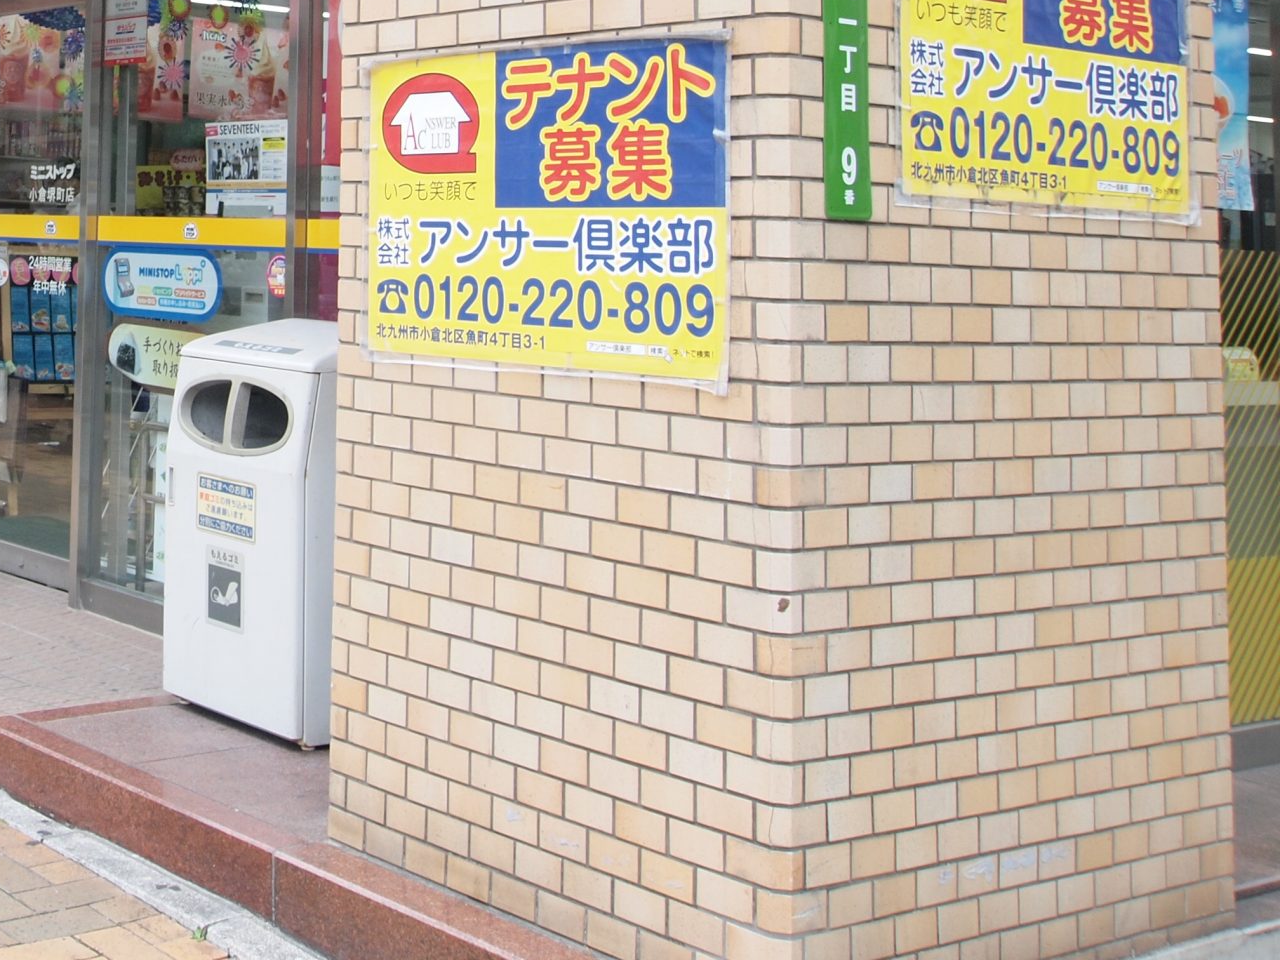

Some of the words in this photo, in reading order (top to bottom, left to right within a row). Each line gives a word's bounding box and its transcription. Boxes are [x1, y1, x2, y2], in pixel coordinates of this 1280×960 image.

[910, 40, 944, 68] 株式
[503, 43, 716, 129] テナント
[910, 69, 944, 97] 会社
[954, 46, 1179, 123] アンサー倶楽部
[219, 123, 260, 136] SEVENTEEN
[949, 107, 1180, 177] 0120-220-809
[30, 163, 76, 180] ミニストップ
[539, 122, 673, 202] 募集
[29, 186, 75, 203] 小倉堺町店
[383, 180, 477, 202] いつも笑顔で
[378, 218, 410, 240] 株式
[378, 243, 410, 265] 会社
[419, 217, 715, 275] アンサー倶楽部
[28, 255, 72, 273] 24時間営業
[138, 266, 175, 279] MINISTOP
[32, 279, 67, 296] 年中無休
[414, 274, 715, 337] 0120-220-809
[376, 323, 546, 350] 北九州市小倉北区魚町4丁目3-1
[211, 550, 240, 565] もえるゴミ
